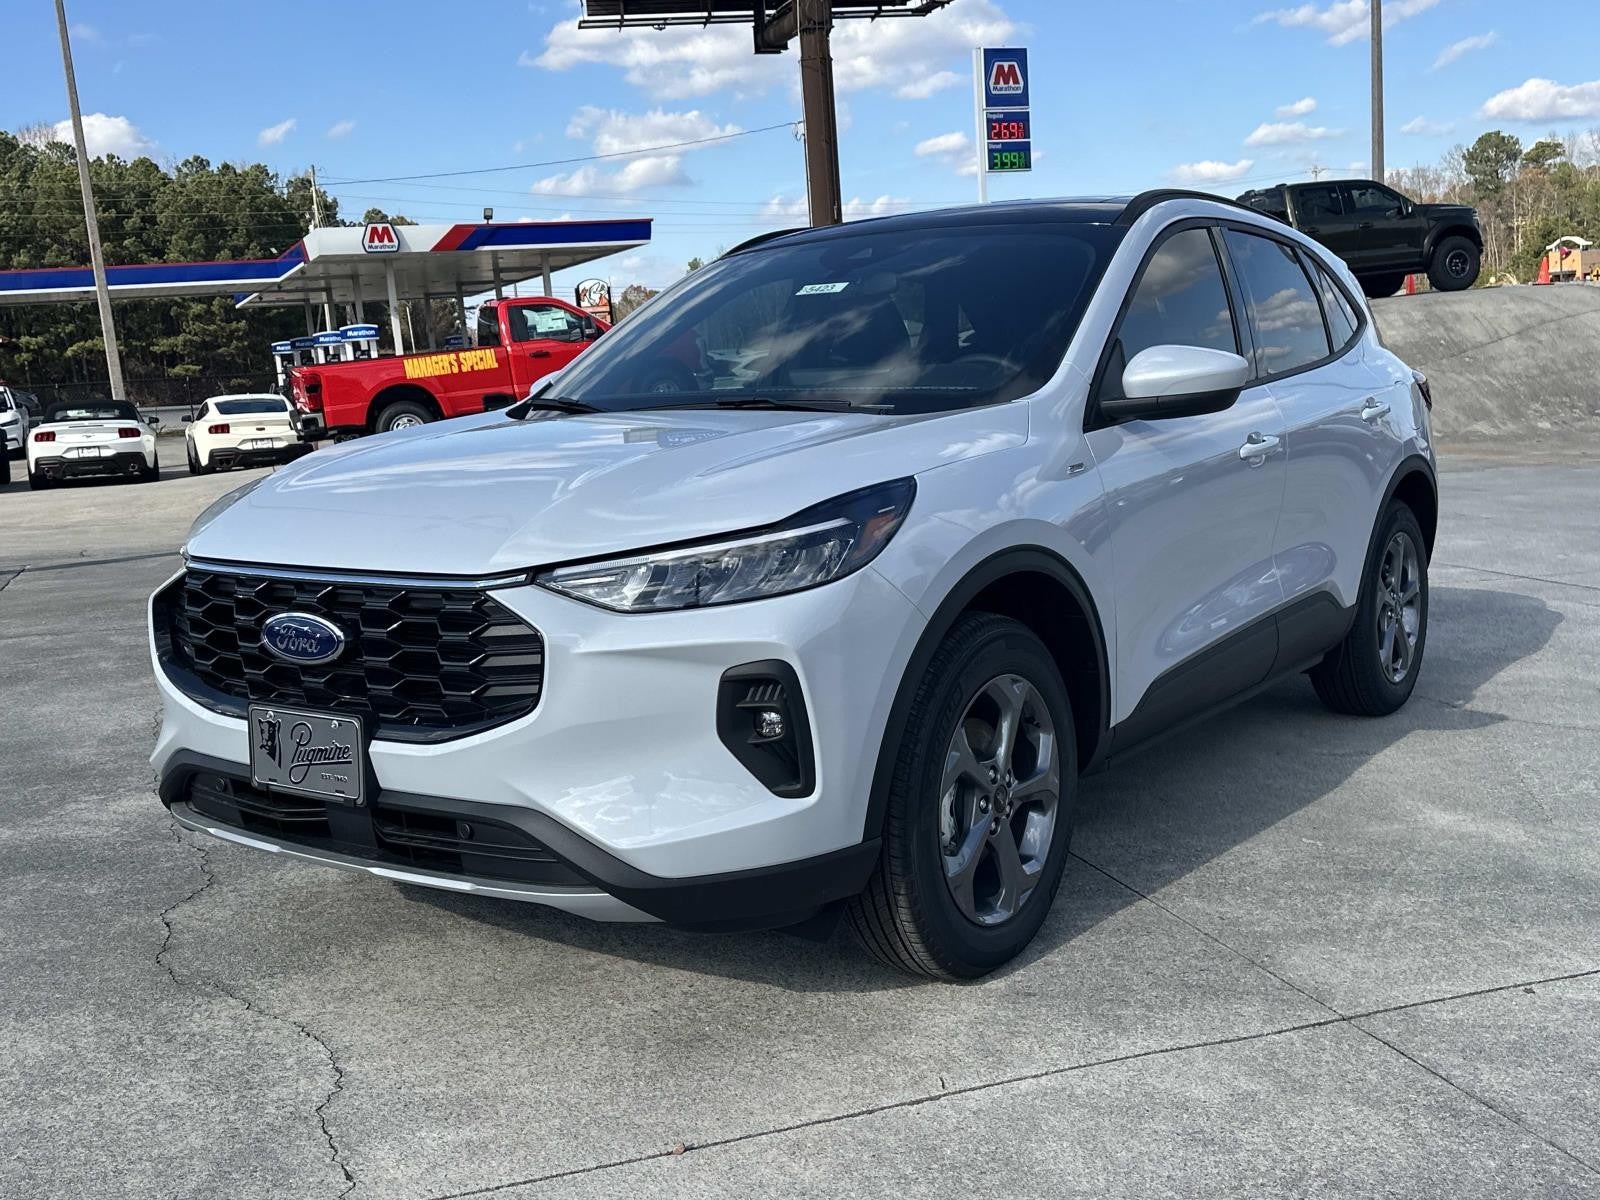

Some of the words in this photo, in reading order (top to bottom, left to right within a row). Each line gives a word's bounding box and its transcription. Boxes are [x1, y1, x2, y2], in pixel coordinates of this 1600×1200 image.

[993, 64, 1020, 85] M
[368, 226, 394, 243] M
[459, 348, 499, 373] SPECIAL
[274, 623, 320, 653] Ford
[289, 721, 353, 784] Pugmire
